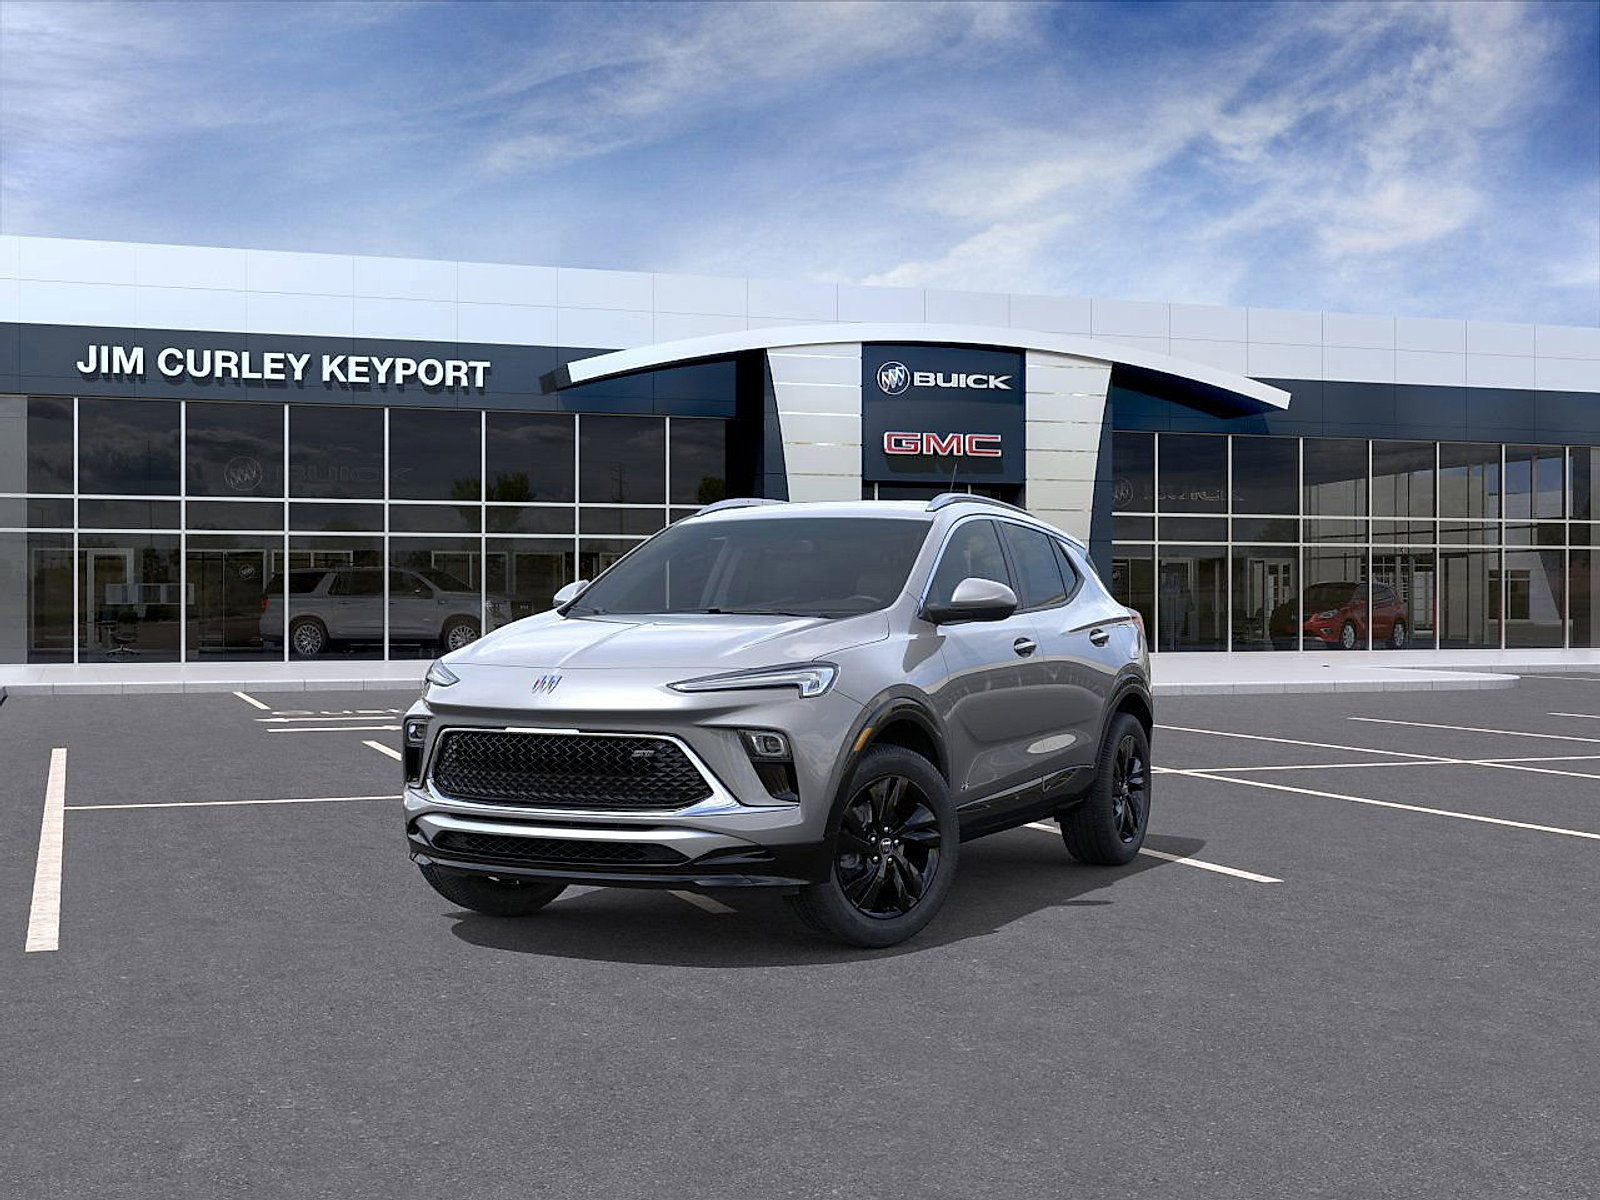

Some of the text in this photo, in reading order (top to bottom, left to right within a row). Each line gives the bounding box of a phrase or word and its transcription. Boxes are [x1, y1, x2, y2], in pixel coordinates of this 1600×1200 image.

[76, 344, 491, 388] JIM CURLEY KEYPORT
[913, 371, 1013, 390] BUICK
[883, 431, 1002, 458] GMC
